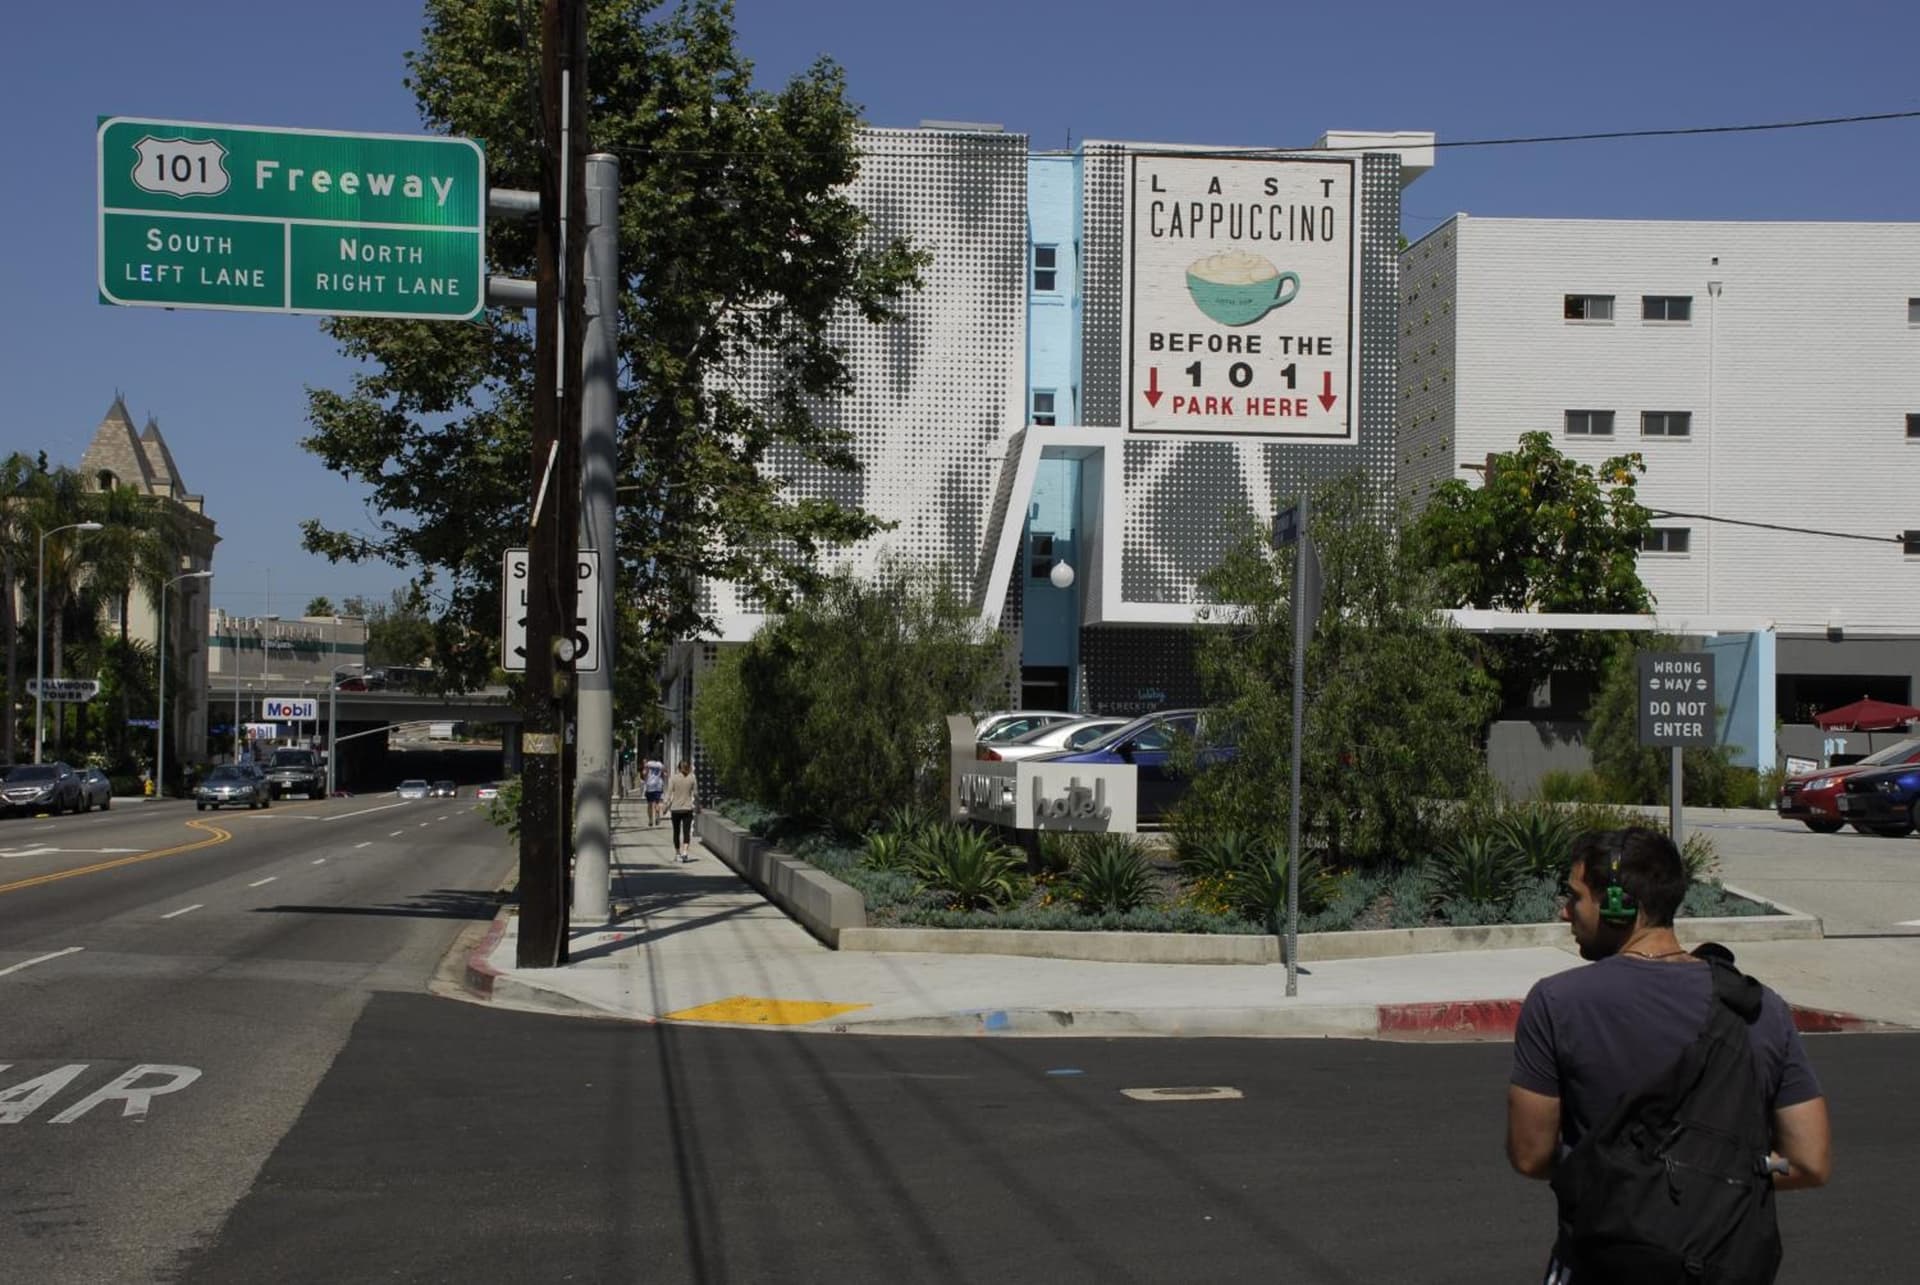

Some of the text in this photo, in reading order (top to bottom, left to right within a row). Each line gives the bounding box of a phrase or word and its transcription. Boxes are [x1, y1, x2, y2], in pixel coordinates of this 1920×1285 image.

[156, 154, 454, 206] 101 Freeway
[1151, 174, 1334, 198] LAST
[1151, 201, 1334, 241] CAPPUCCINO
[146, 228, 232, 255] SOUTH
[340, 238, 423, 264] NORTH
[126, 264, 265, 287] LEFT LANE
[316, 274, 460, 296] RIGHT LANE
[1150, 333, 1333, 355] BEFORE THE
[1186, 361, 1297, 389] 101
[1172, 396, 1308, 416] PARK HERE
[1654, 661, 1701, 674] WRONG
[1664, 678, 1692, 693] WAY
[267, 703, 312, 717] Mobil
[1649, 702, 1707, 716] DO NOT
[247, 726, 273, 739] obil
[1654, 722, 1704, 737] ENTER
[1033, 776, 1112, 819] hotel
[0, 1064, 202, 1124] AR
